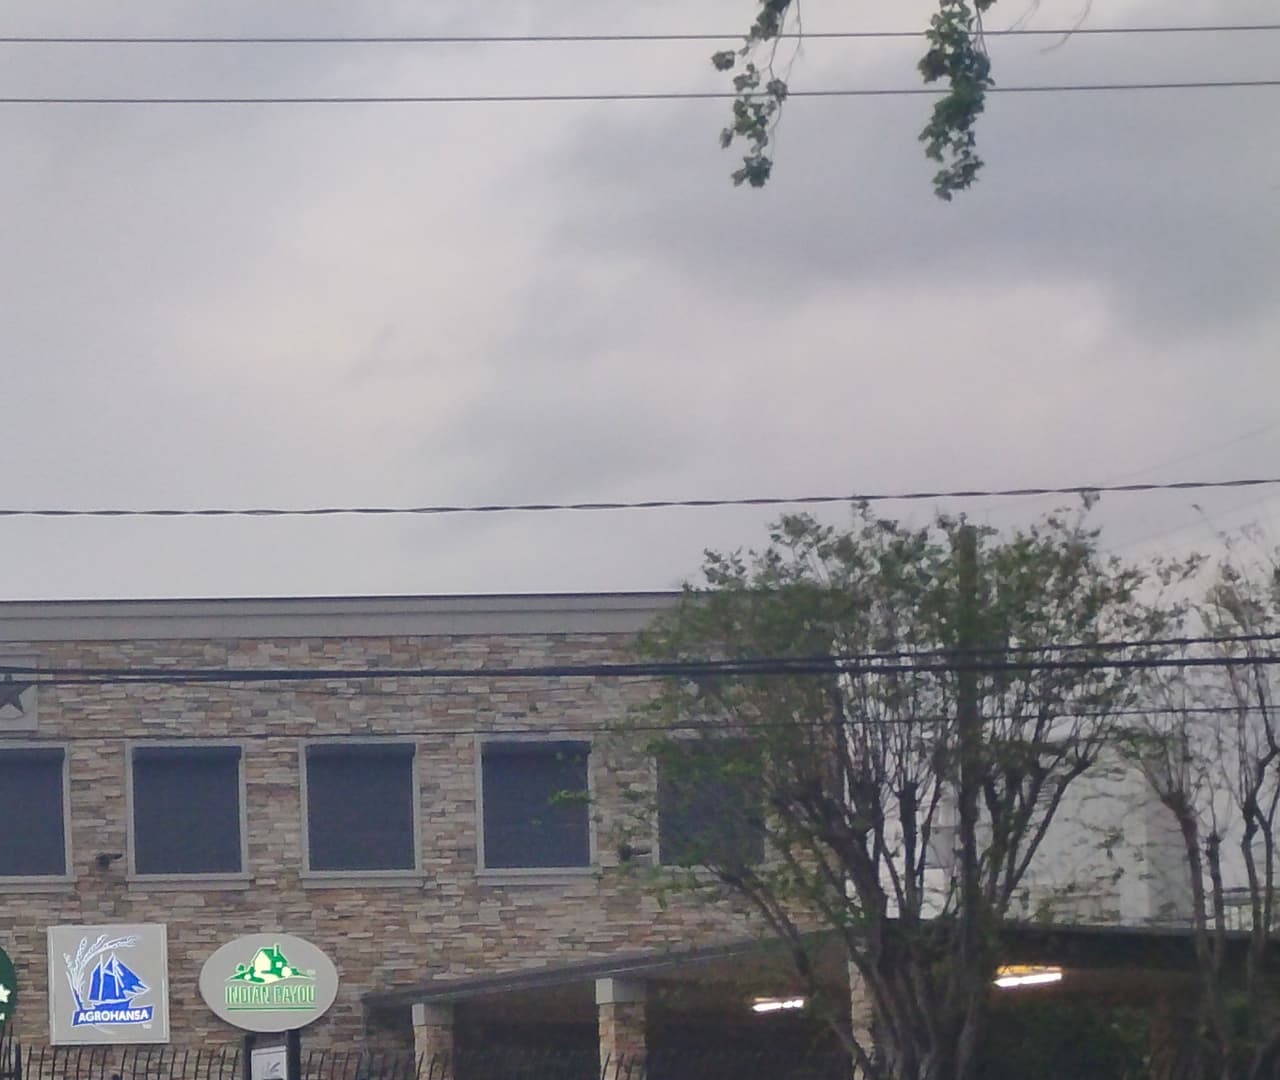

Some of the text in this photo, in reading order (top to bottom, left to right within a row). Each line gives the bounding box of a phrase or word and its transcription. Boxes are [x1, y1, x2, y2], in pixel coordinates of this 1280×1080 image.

[224, 983, 316, 1004] INDIAN BAYOU
[78, 1009, 149, 1023] AGROHANSA
